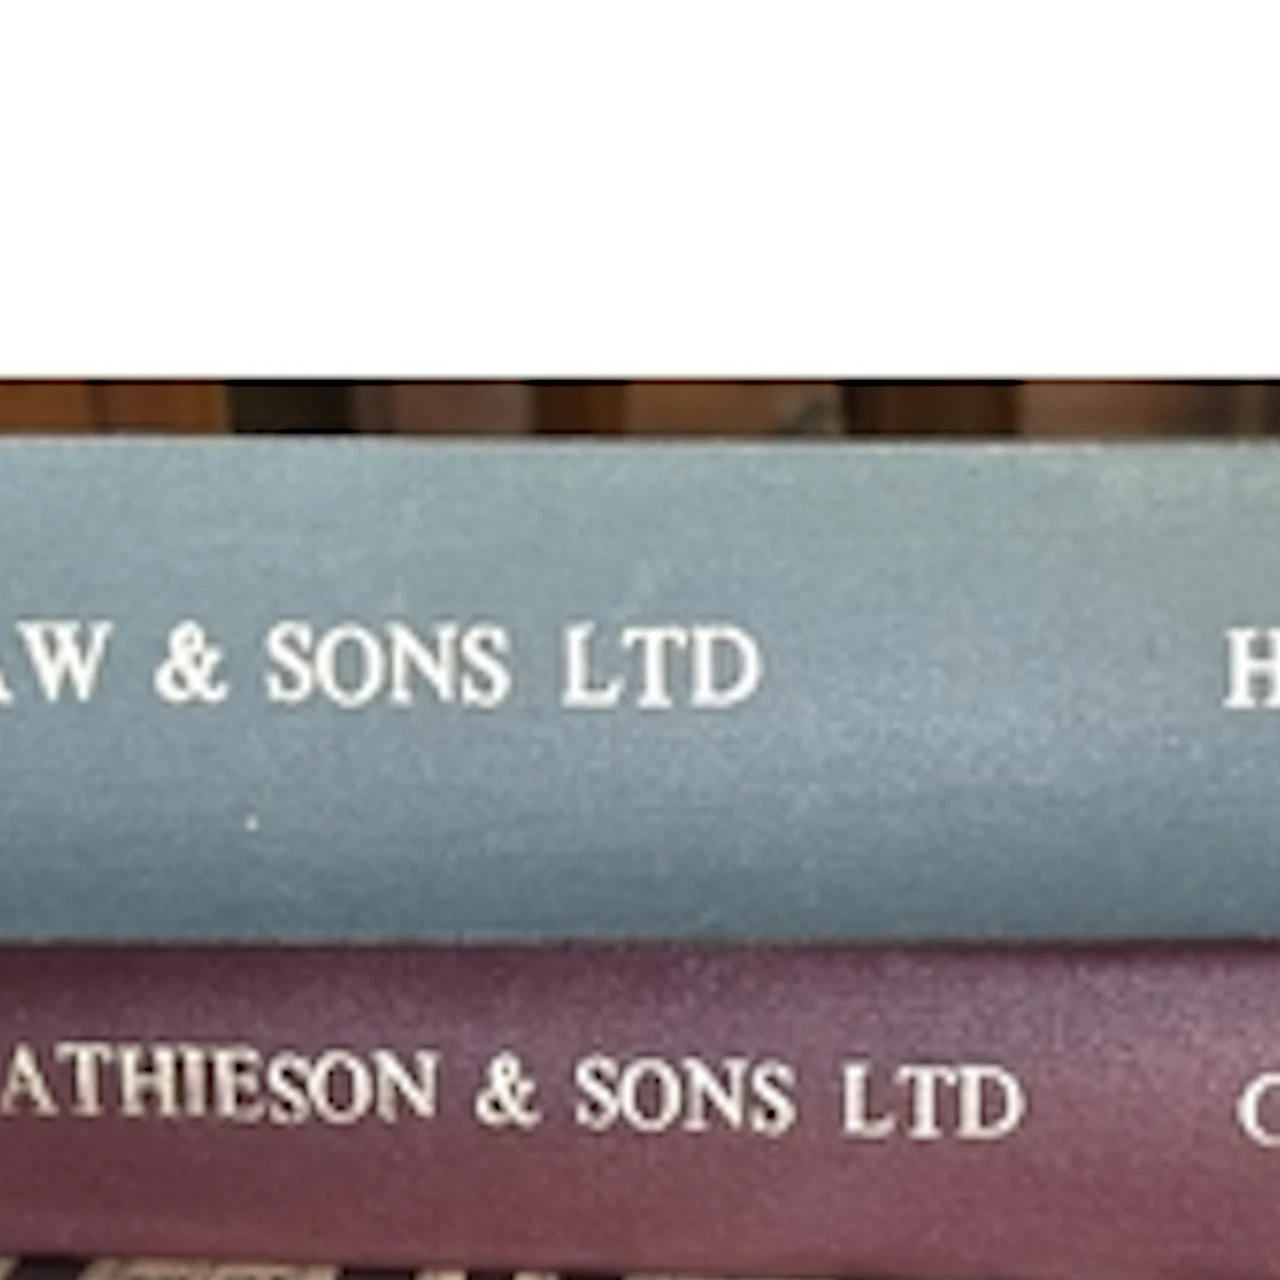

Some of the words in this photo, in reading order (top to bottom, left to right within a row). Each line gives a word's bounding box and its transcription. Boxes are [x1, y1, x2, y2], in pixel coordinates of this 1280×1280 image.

[153, 622, 229, 707] &
[265, 621, 510, 709] SONS
[559, 621, 765, 710] LTD
[471, 1052, 540, 1129] &
[575, 1052, 796, 1136] SONS
[838, 1063, 1024, 1142] LTD
